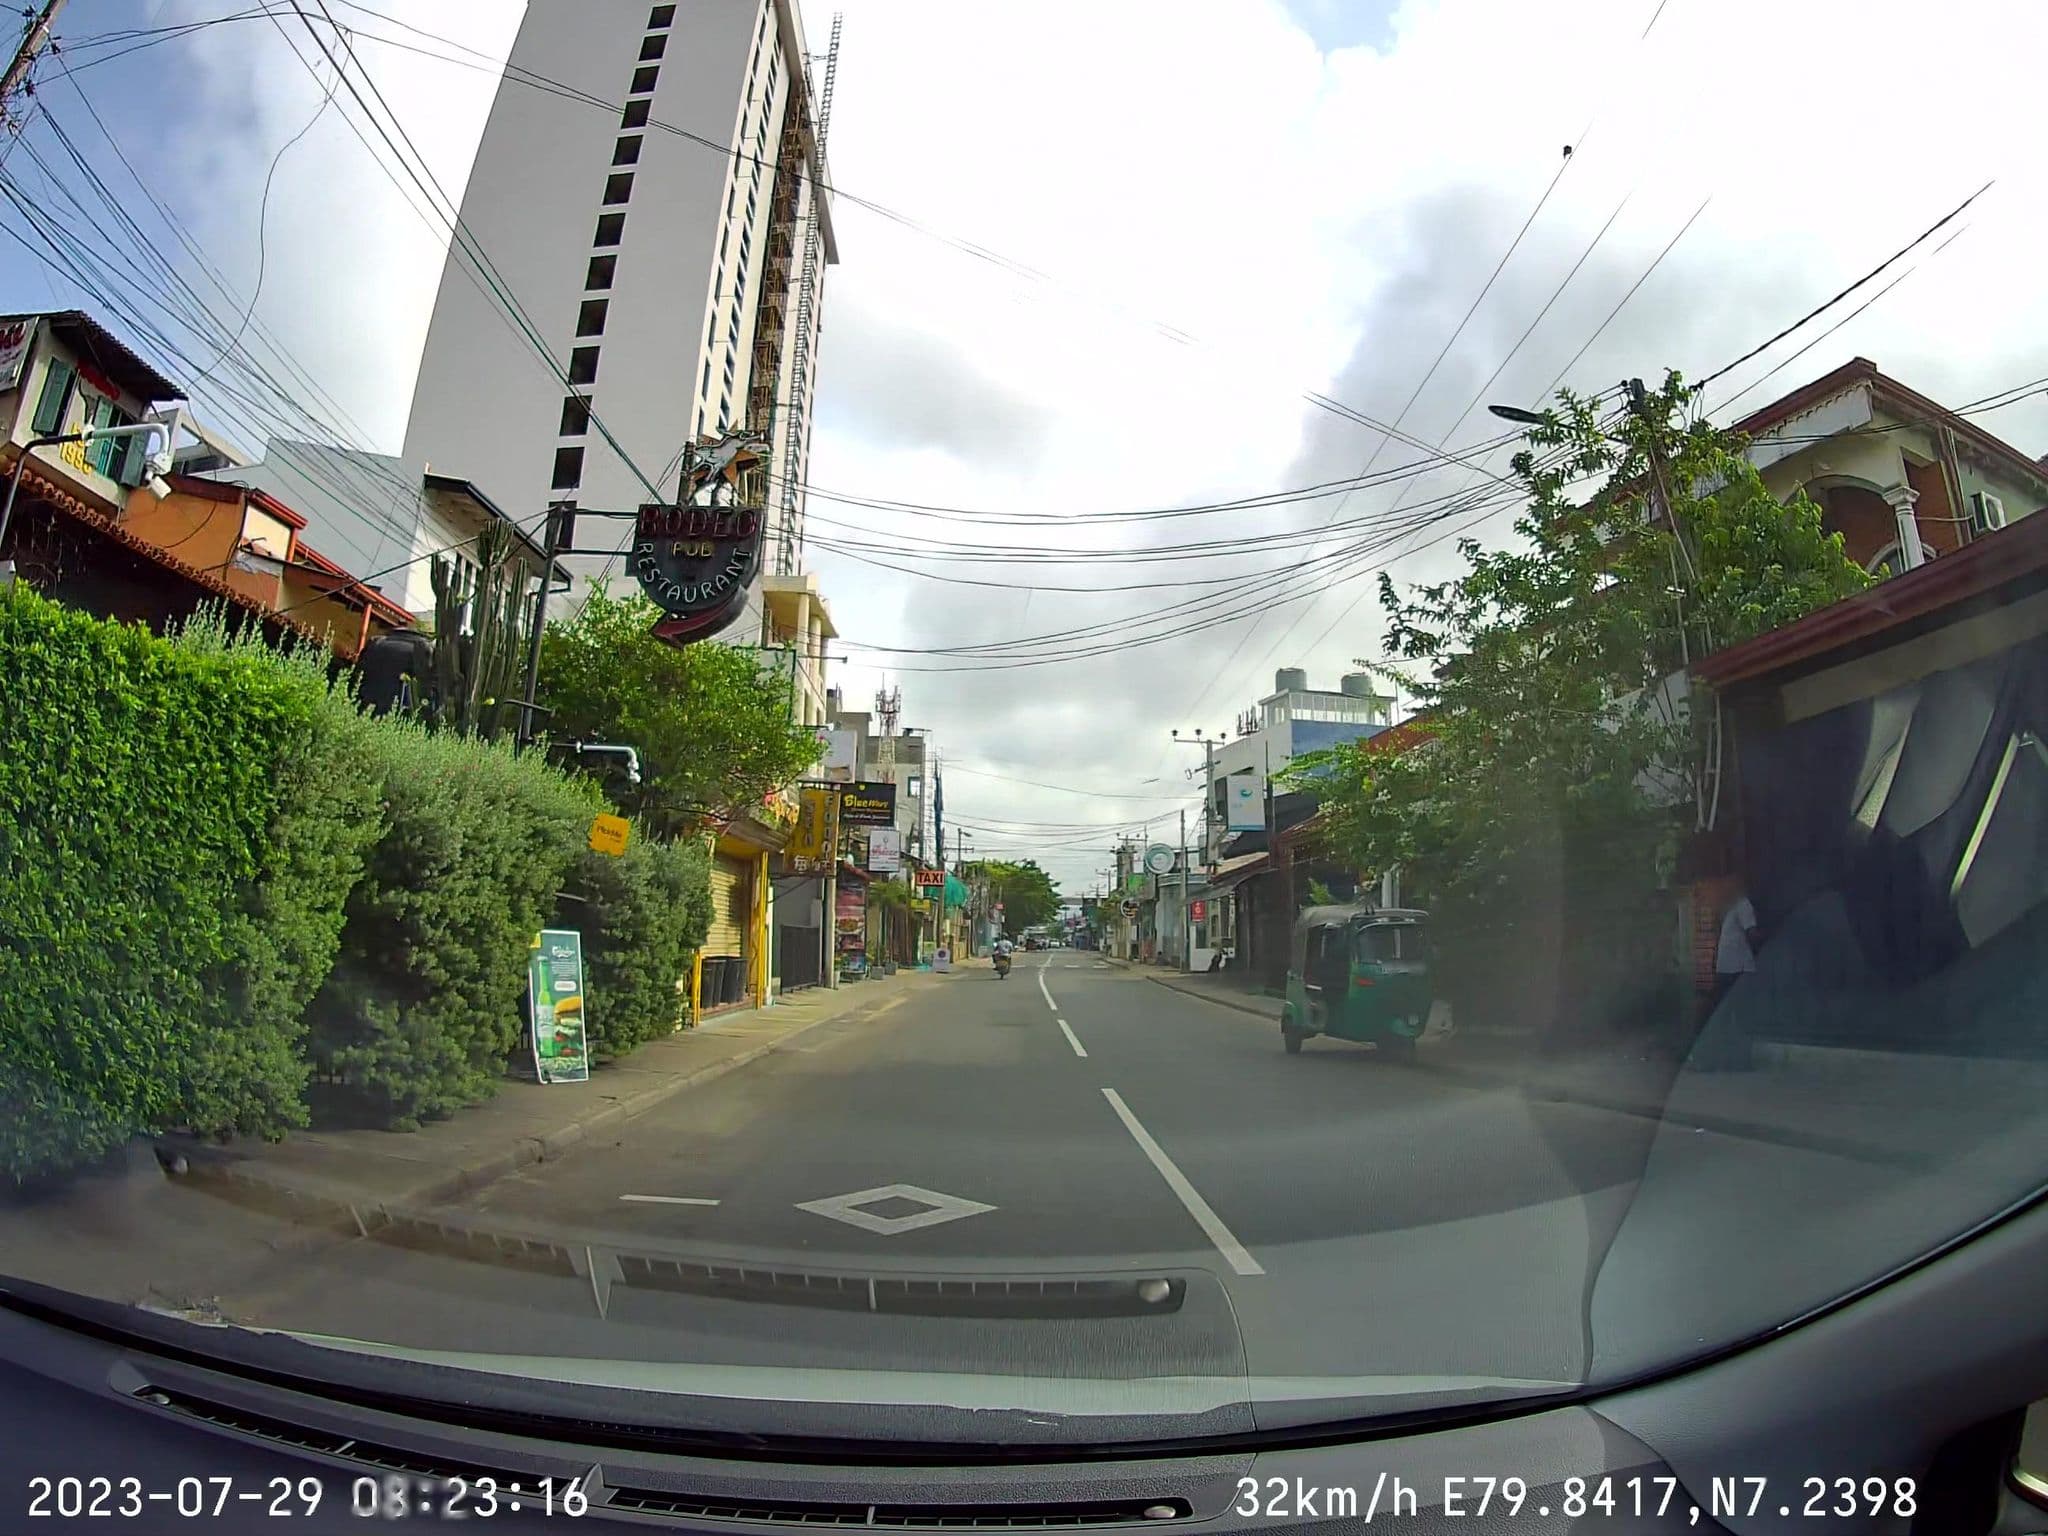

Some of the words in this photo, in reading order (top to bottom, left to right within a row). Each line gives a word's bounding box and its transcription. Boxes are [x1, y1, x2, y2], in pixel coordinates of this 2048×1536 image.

[642, 508, 757, 537] RODEO
[672, 541, 713, 556] PUB
[638, 541, 752, 603] RESTAURANT
[919, 872, 943, 884] TAXI
